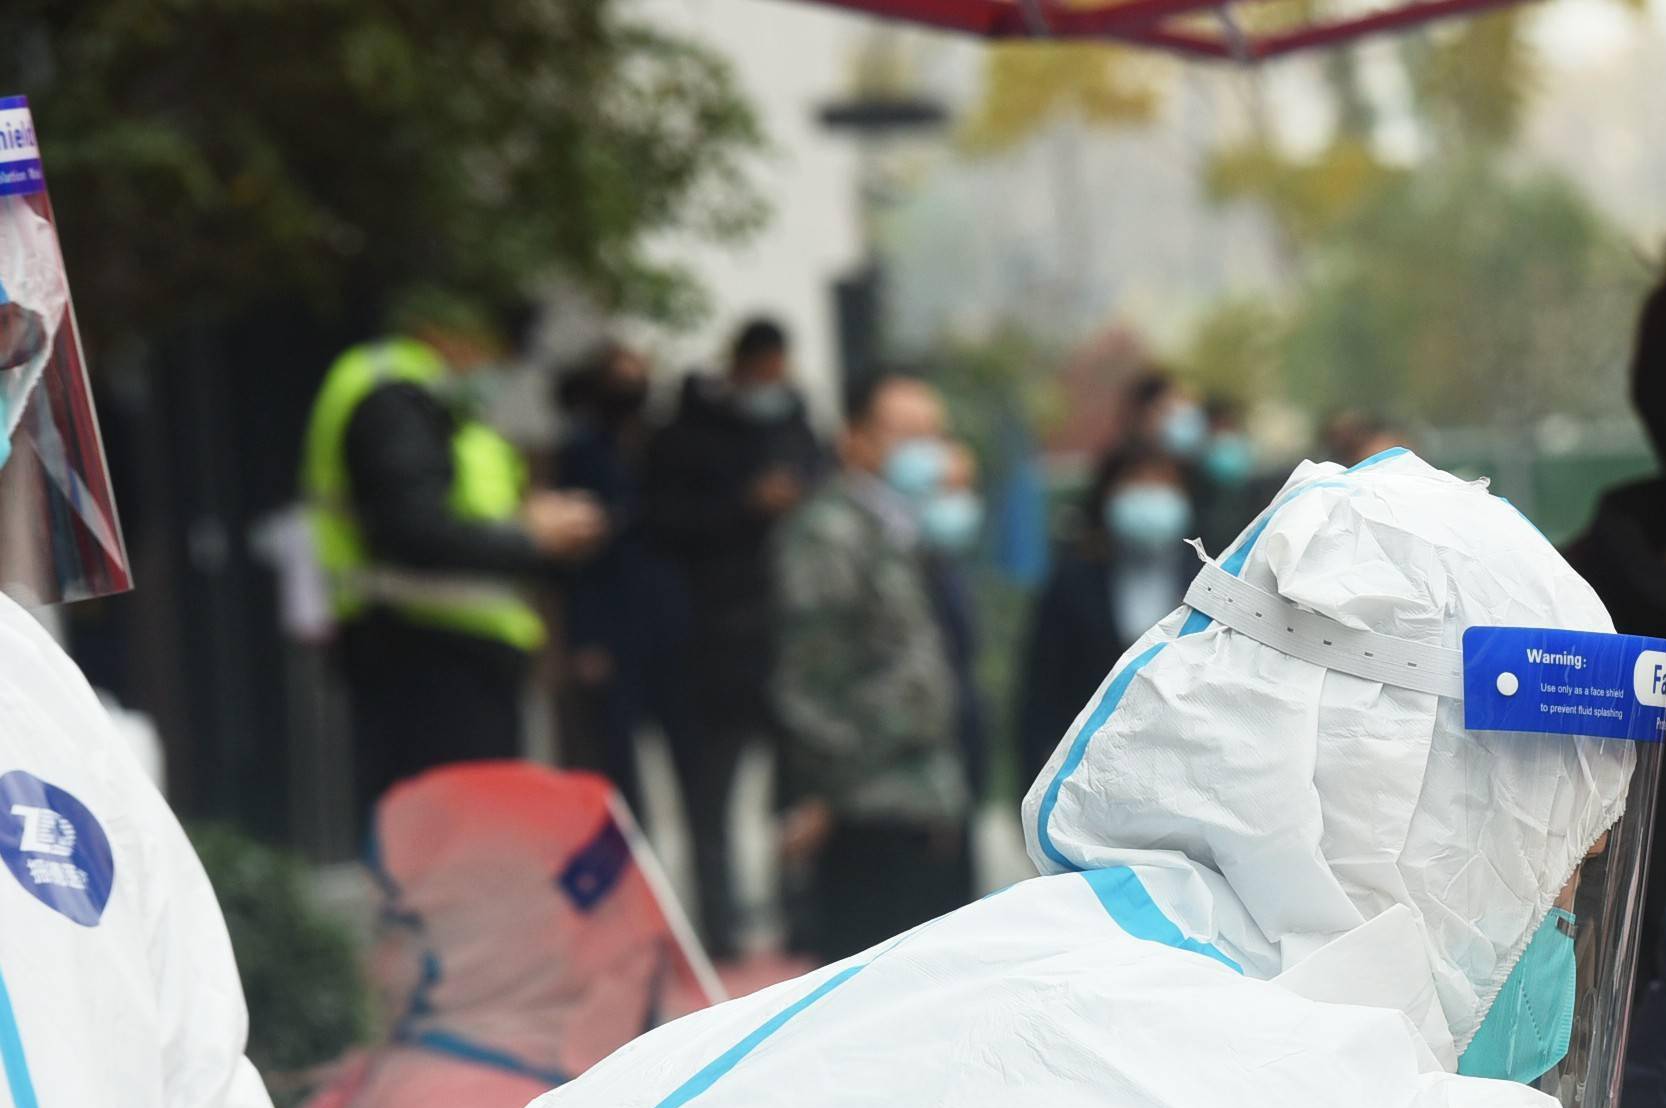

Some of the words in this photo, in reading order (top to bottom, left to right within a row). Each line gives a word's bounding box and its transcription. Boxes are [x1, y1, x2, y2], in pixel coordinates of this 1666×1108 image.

[1526, 648, 1587, 669] Warning:
[1540, 683, 1556, 693] Use
[1557, 684, 1572, 696] only
[1574, 686, 1583, 695] as
[1584, 687, 1589, 695] a
[1590, 686, 1605, 697] face
[1606, 688, 1624, 698] shield
[1540, 703, 1549, 712] to
[1550, 704, 1577, 715] prevent
[1578, 705, 1593, 716] fluid
[1593, 707, 1623, 720] splashing
